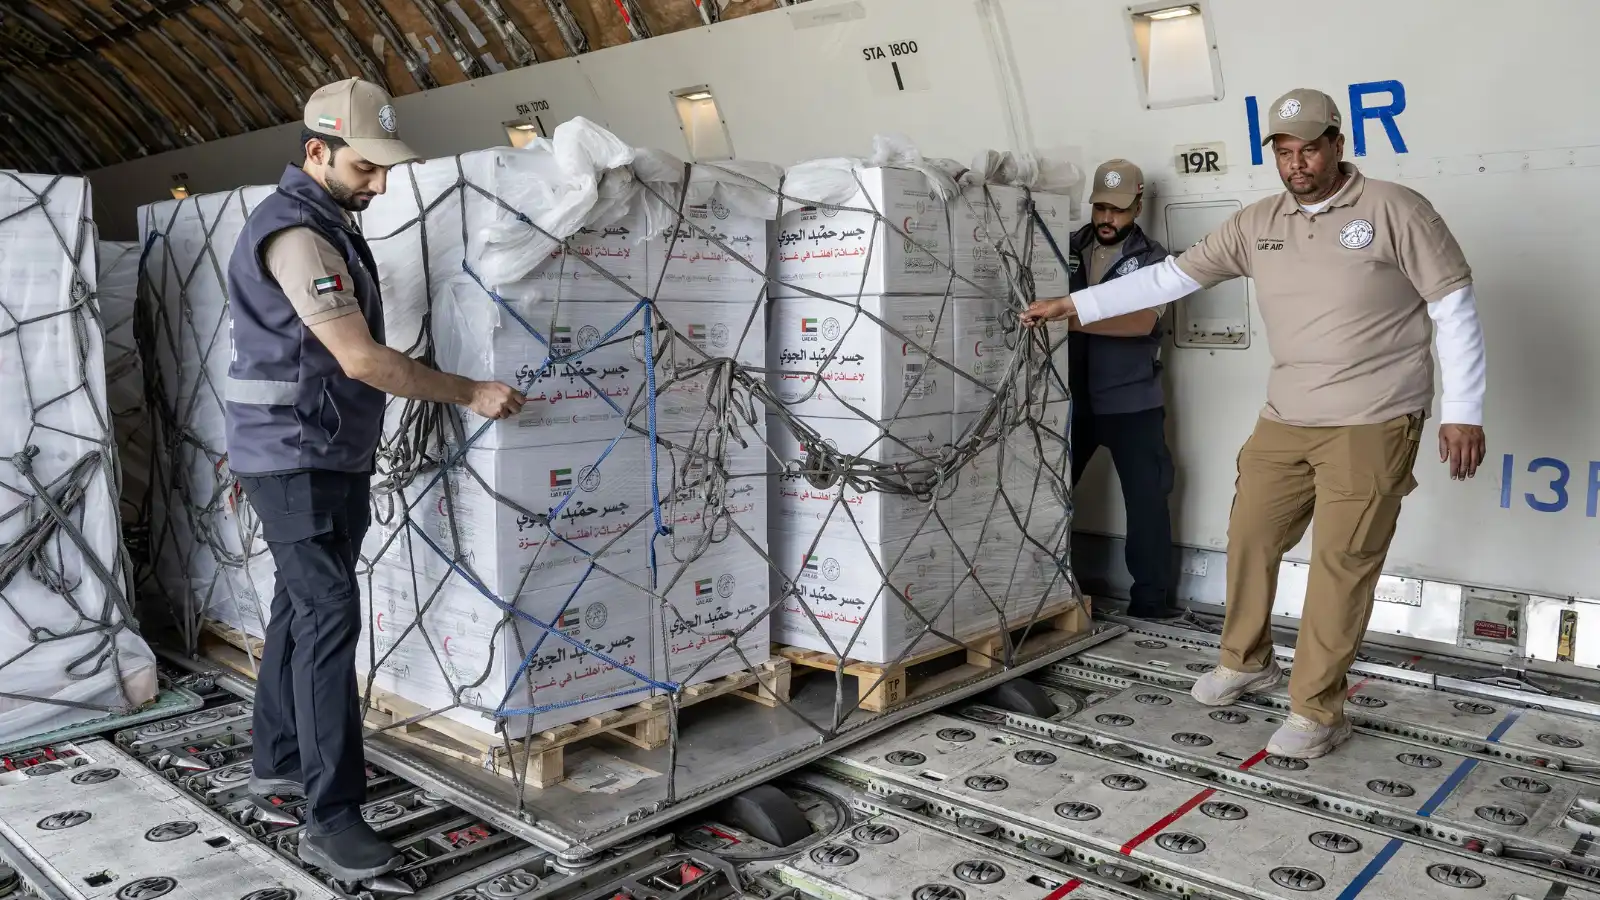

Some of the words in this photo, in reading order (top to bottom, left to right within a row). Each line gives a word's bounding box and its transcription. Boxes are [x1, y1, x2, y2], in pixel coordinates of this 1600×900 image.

[862, 46, 886, 61] STA
[888, 40, 918, 57] 1800
[516, 104, 530, 116] STA
[531, 99, 550, 112] 1700
[1180, 151, 1221, 174] 19R
[600, 226, 630, 240] جسر
[777, 228, 806, 248] الجوي
[839, 227, 865, 242] جسر
[811, 247, 833, 259] أهلنا
[1257, 243, 1269, 251] UAE
[1269, 243, 1284, 251] AID
[779, 251, 799, 263] غزة
[800, 250, 810, 263] في
[780, 348, 807, 366] الجوي
[838, 353, 865, 366] جسر
[598, 364, 630, 380] جسر
[549, 390, 562, 404] في
[599, 501, 630, 518] جسر
[838, 596, 865, 610] جسر
[733, 603, 758, 620] جسر
[605, 635, 636, 653] جسر
[671, 641, 694, 655] غزة
[695, 636, 706, 650] في
[558, 672, 572, 688] في
[888, 679, 900, 692] TP
